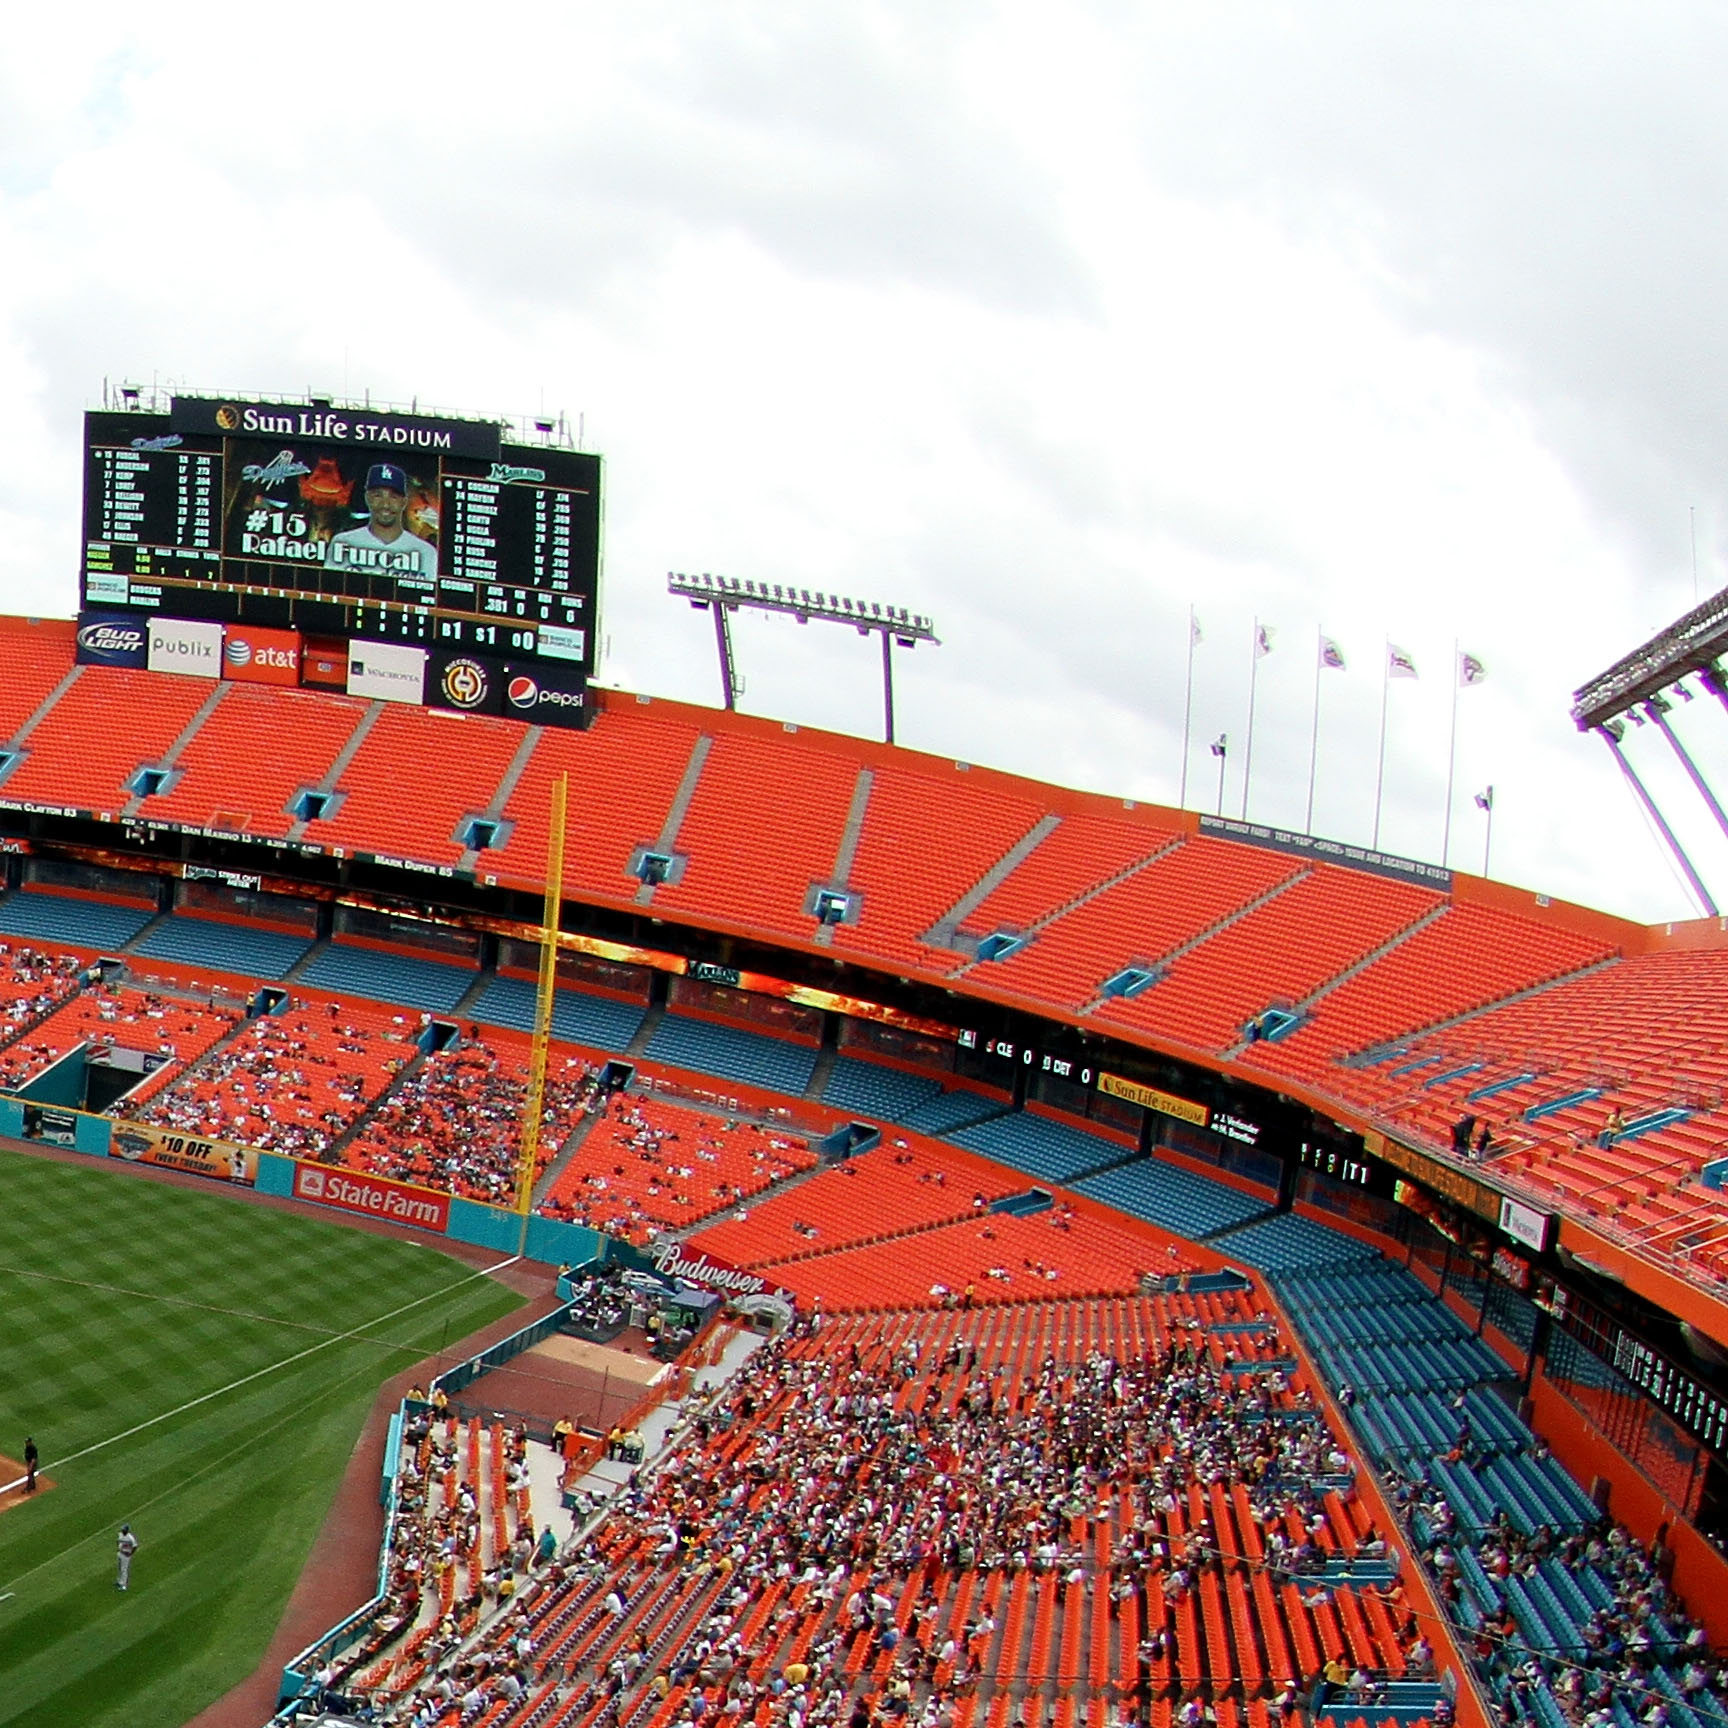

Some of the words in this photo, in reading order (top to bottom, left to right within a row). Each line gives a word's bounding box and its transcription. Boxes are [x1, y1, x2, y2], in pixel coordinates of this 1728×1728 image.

[244, 409, 293, 434] Sun
[299, 413, 347, 438] Life
[355, 424, 451, 449] STADIUM
[245, 509, 306, 537] #15
[243, 533, 326, 561] Rafael
[334, 541, 420, 571] Furcal
[85, 637, 143, 651] LIGHT
[95, 628, 141, 641] BUD
[152, 638, 212, 657] Publix
[254, 647, 297, 669] at&t
[539, 690, 583, 707] pepsi
[181, 824, 201, 836] DAN
[1023, 1050, 1032, 1064] 0
[1081, 1068, 1090, 1083] 0
[1113, 1082, 1136, 1099] Sun
[1137, 1090, 1159, 1107] Life
[1160, 1101, 1203, 1123] STADIUM
[161, 1135, 184, 1152] $10
[187, 1140, 212, 1159] OFF
[154, 1153, 178, 1167] EVERY
[654, 1244, 764, 1292] Budweiser
